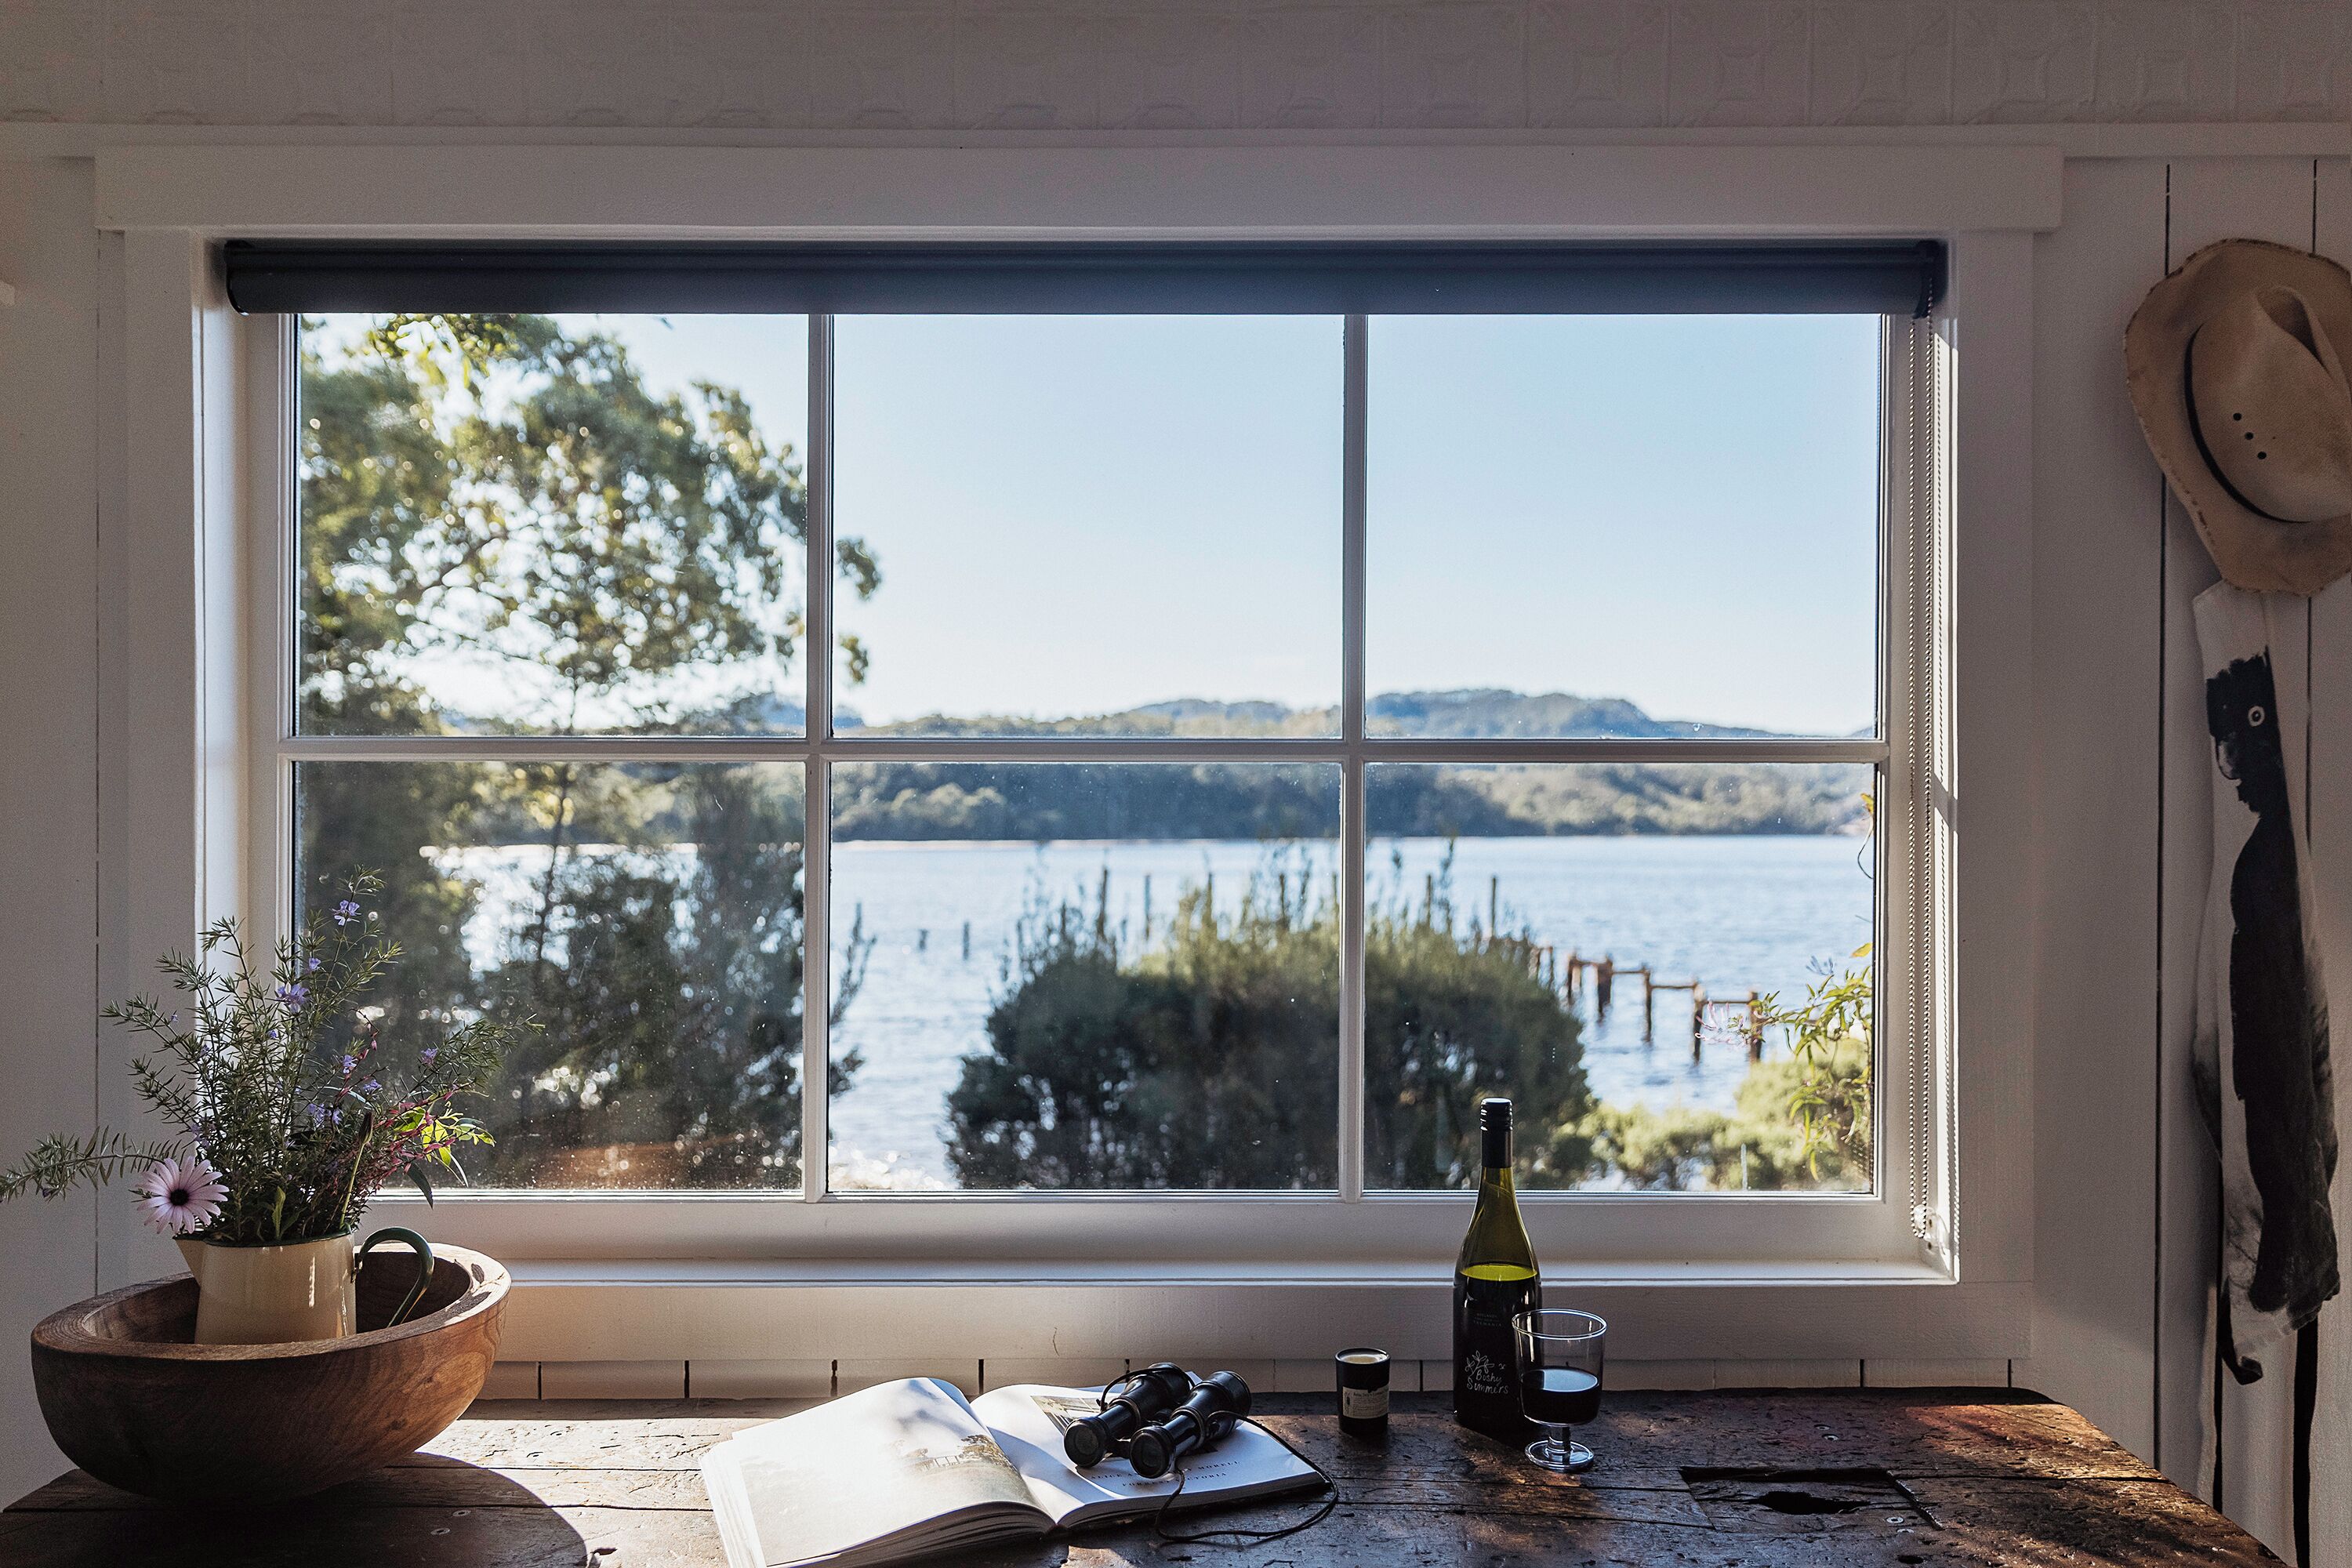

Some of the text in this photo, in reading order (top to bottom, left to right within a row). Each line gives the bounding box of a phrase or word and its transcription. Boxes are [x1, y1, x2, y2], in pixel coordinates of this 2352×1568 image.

[1475, 1369, 1502, 1386] Bushy
[1466, 1377, 1509, 1394] Summers
[1197, 1460, 1241, 1469] MORELL
[1175, 1472, 1226, 1482] VCTORIA
